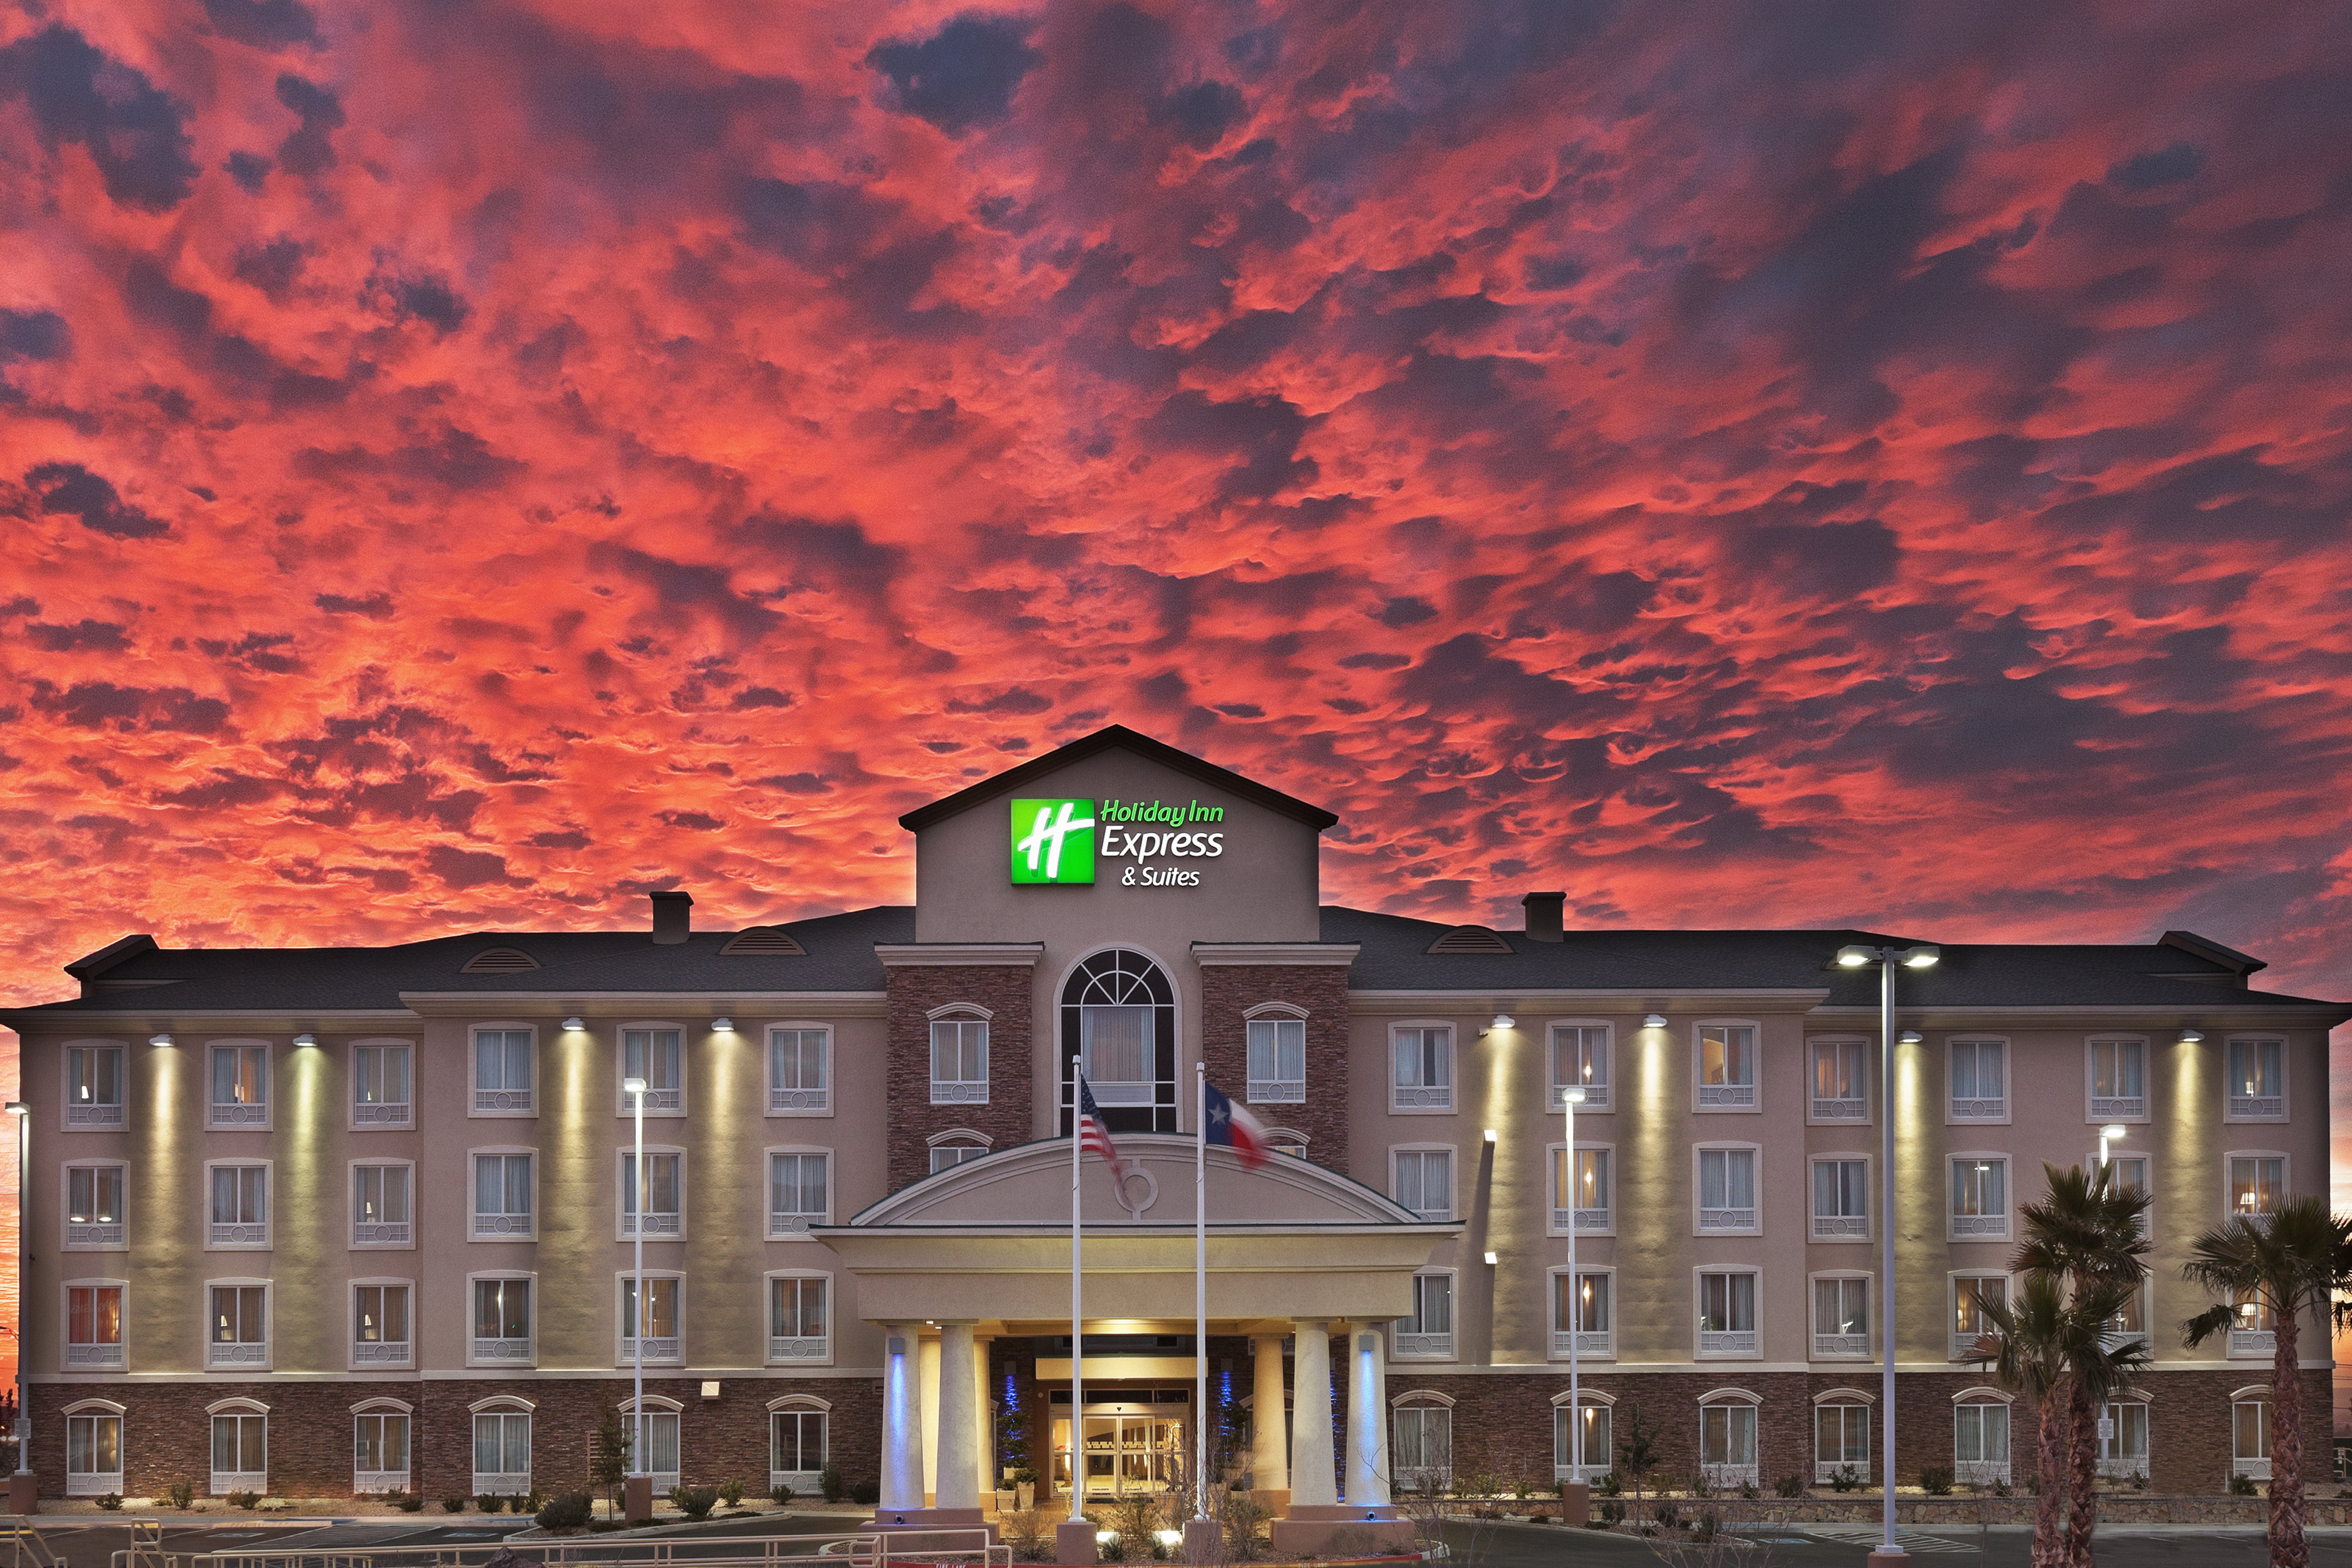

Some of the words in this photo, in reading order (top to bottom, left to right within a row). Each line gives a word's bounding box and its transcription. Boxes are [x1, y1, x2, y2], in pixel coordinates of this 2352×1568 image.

[1100, 800, 1185, 827] Holiday
[1188, 800, 1223, 822] Inn
[1101, 825, 1223, 865] Express
[1121, 866, 1136, 886] &
[1140, 866, 1200, 886] Suites
